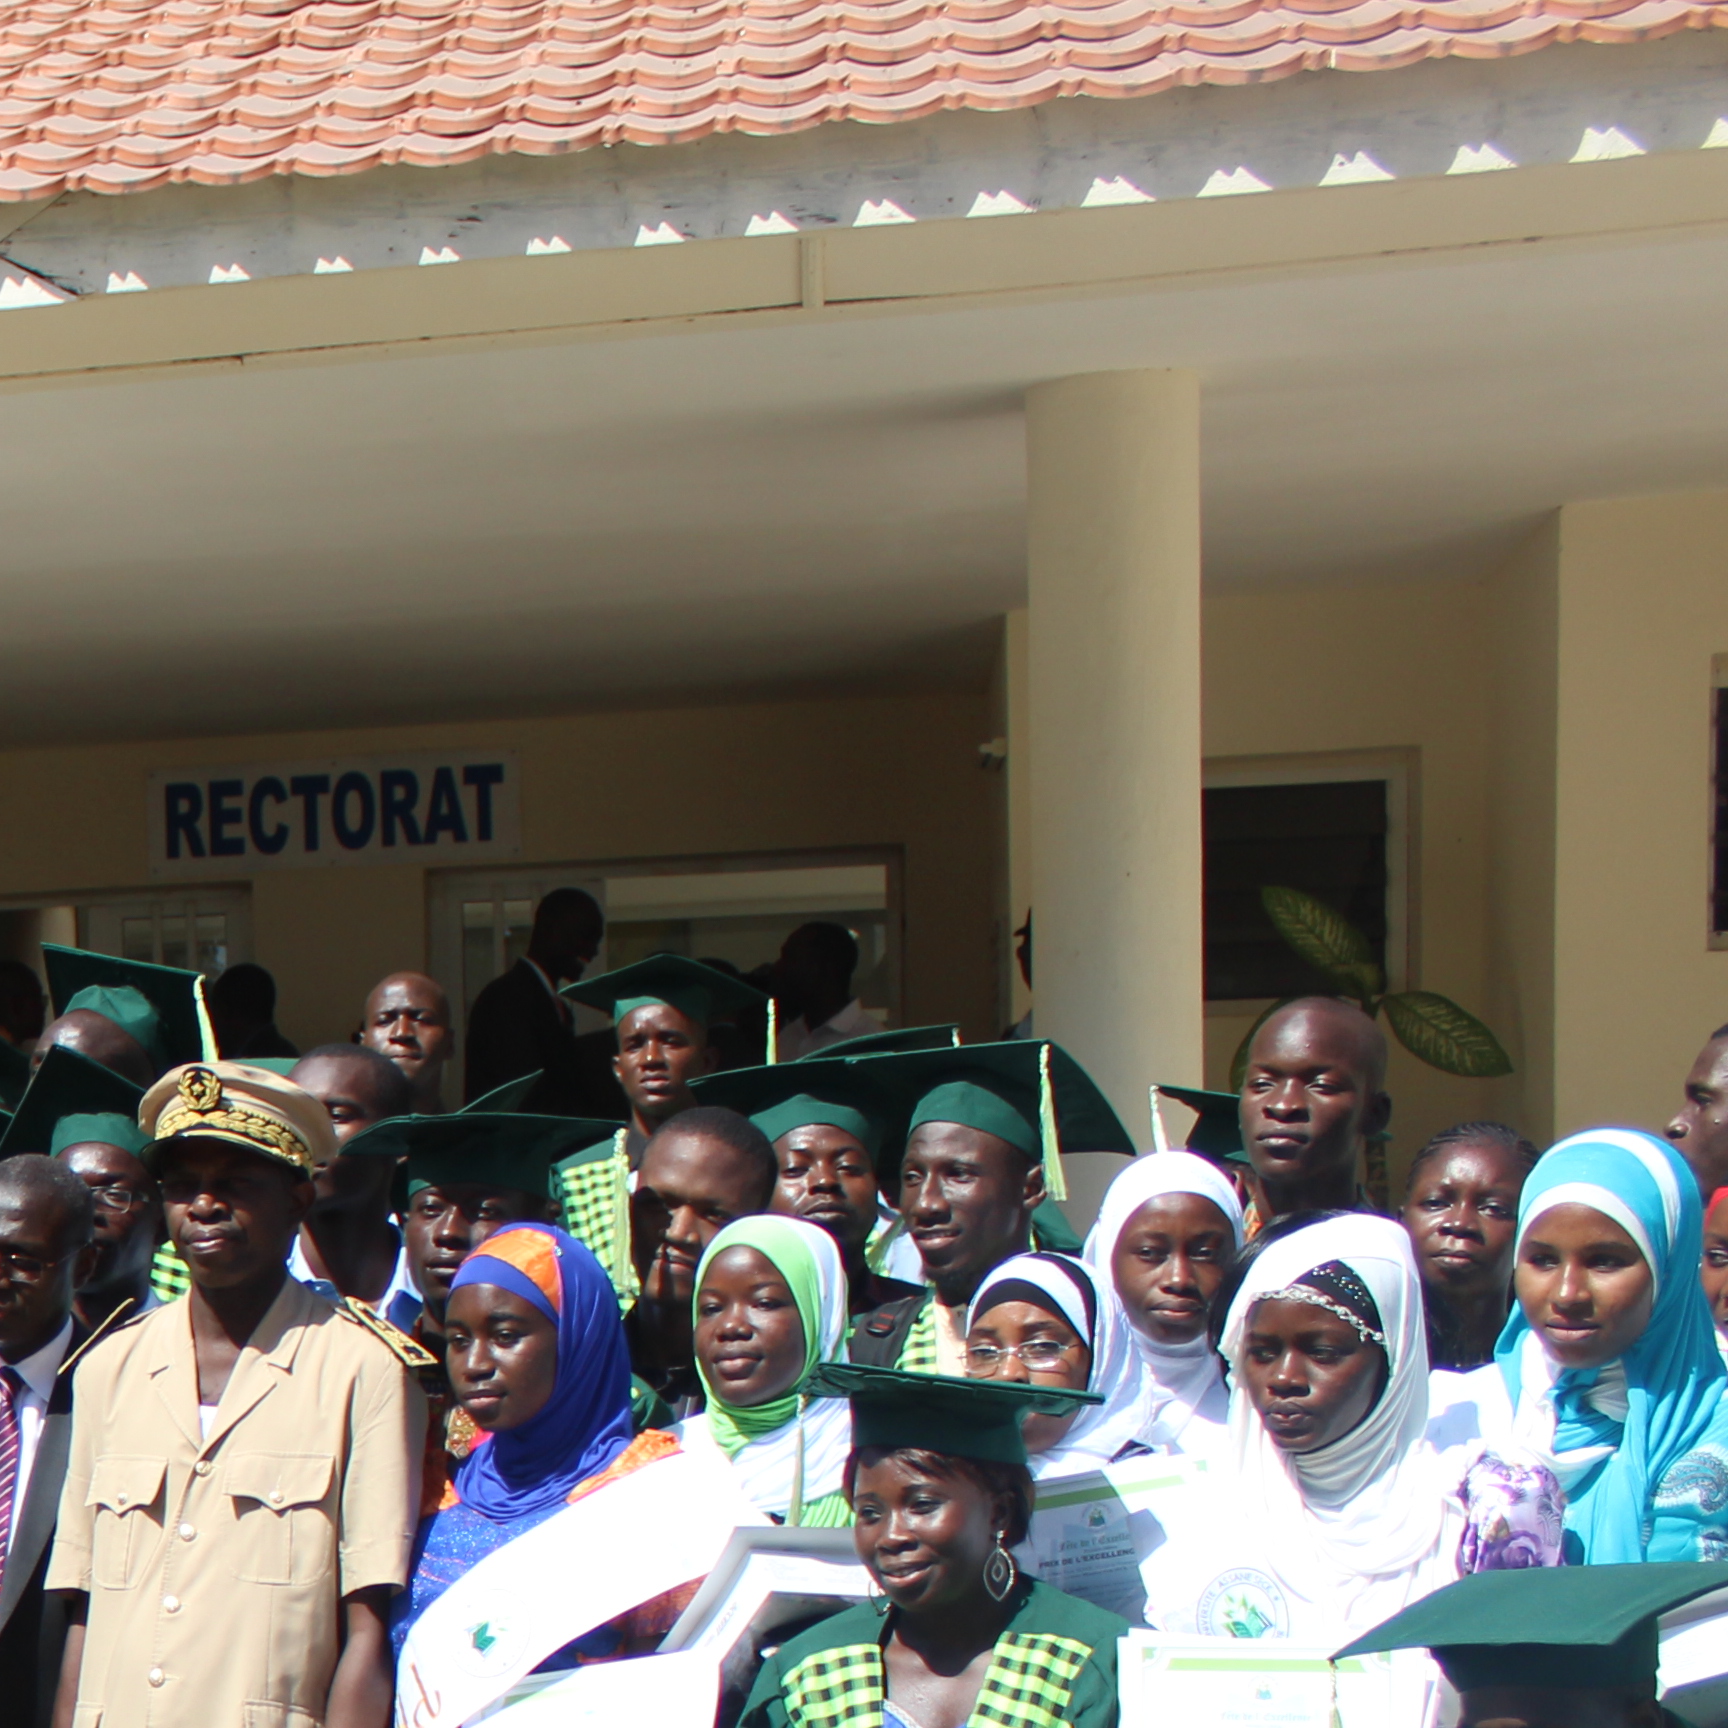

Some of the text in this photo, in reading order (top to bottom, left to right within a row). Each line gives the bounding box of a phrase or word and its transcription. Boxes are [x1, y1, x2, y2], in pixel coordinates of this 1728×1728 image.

[165, 763, 505, 860] RECTORAT
[1039, 1548, 1135, 1569] PRIX DE L'EXCELLENC
